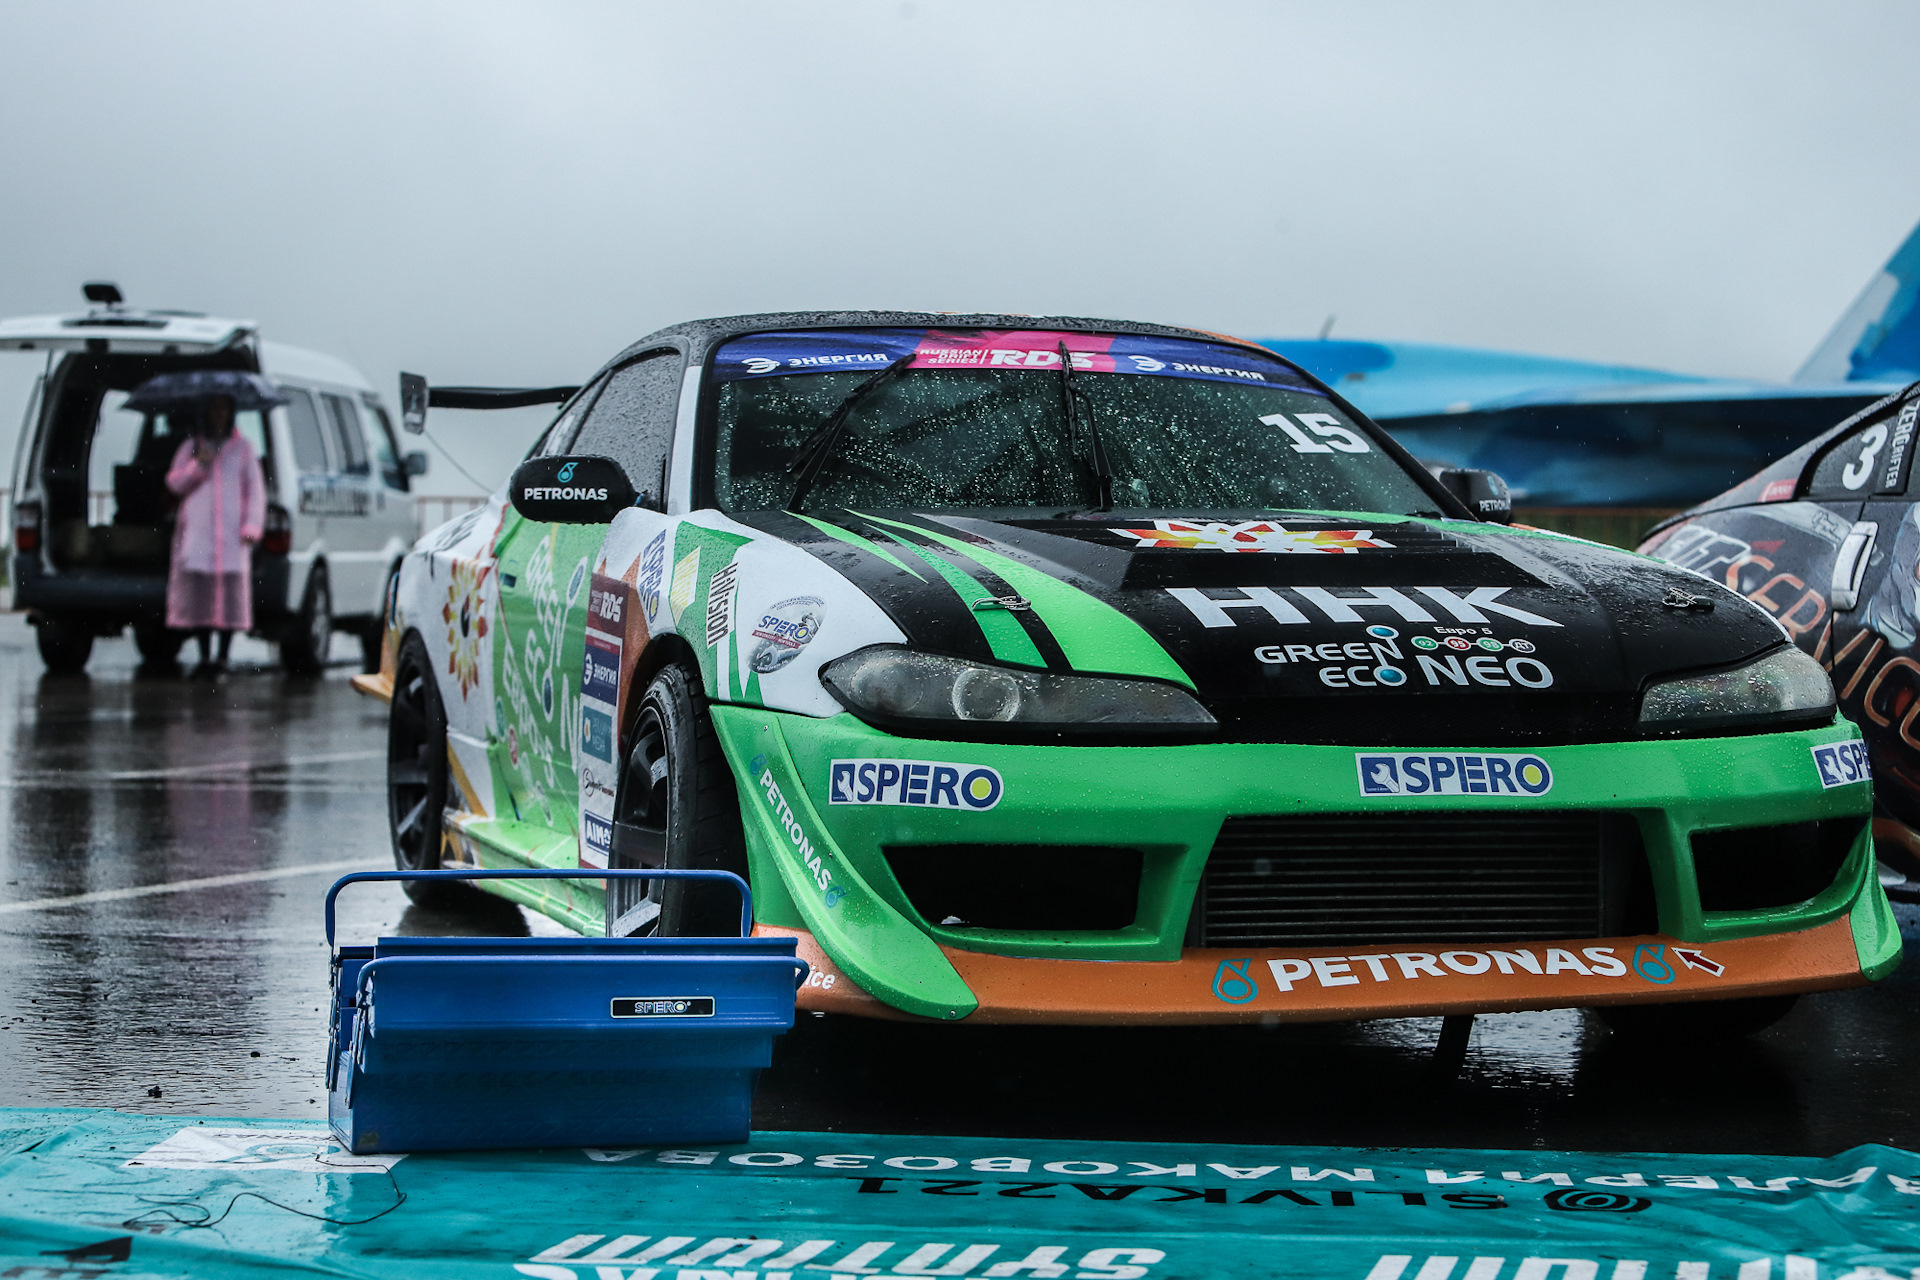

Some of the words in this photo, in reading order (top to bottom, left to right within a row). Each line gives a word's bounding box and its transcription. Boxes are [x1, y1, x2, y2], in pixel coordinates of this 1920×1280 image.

[789, 353, 889, 367] ЭНЕРГИЯ
[990, 350, 1096, 368] RDS
[1173, 362, 1265, 381] ЭНЕРГИЯ
[1258, 413, 1371, 453] 15
[1842, 423, 1888, 490] 3
[524, 487, 608, 501] PETRONAS
[600, 591, 624, 622] RDS
[708, 562, 739, 645] HiVision
[758, 615, 809, 639] SPERO
[1434, 627, 1477, 635] Евро
[1254, 640, 1404, 665] GREEN
[1418, 639, 1434, 648] 92
[1451, 640, 1468, 648] 95
[1483, 640, 1501, 649] 98
[593, 663, 617, 686] ЭНЕРГИЯ
[1318, 664, 1408, 688] ECO
[1415, 655, 1554, 689] NEO
[857, 763, 1001, 808] SPERO
[1402, 756, 1550, 794] SPERO
[760, 768, 832, 891] PETRONAS
[1267, 946, 1628, 991] PETRONAS
[634, 1001, 688, 1013] SPERO
[848, 1176, 1509, 1210] SLIVKA221
[527, 1233, 1166, 1280] SYNTIUM
